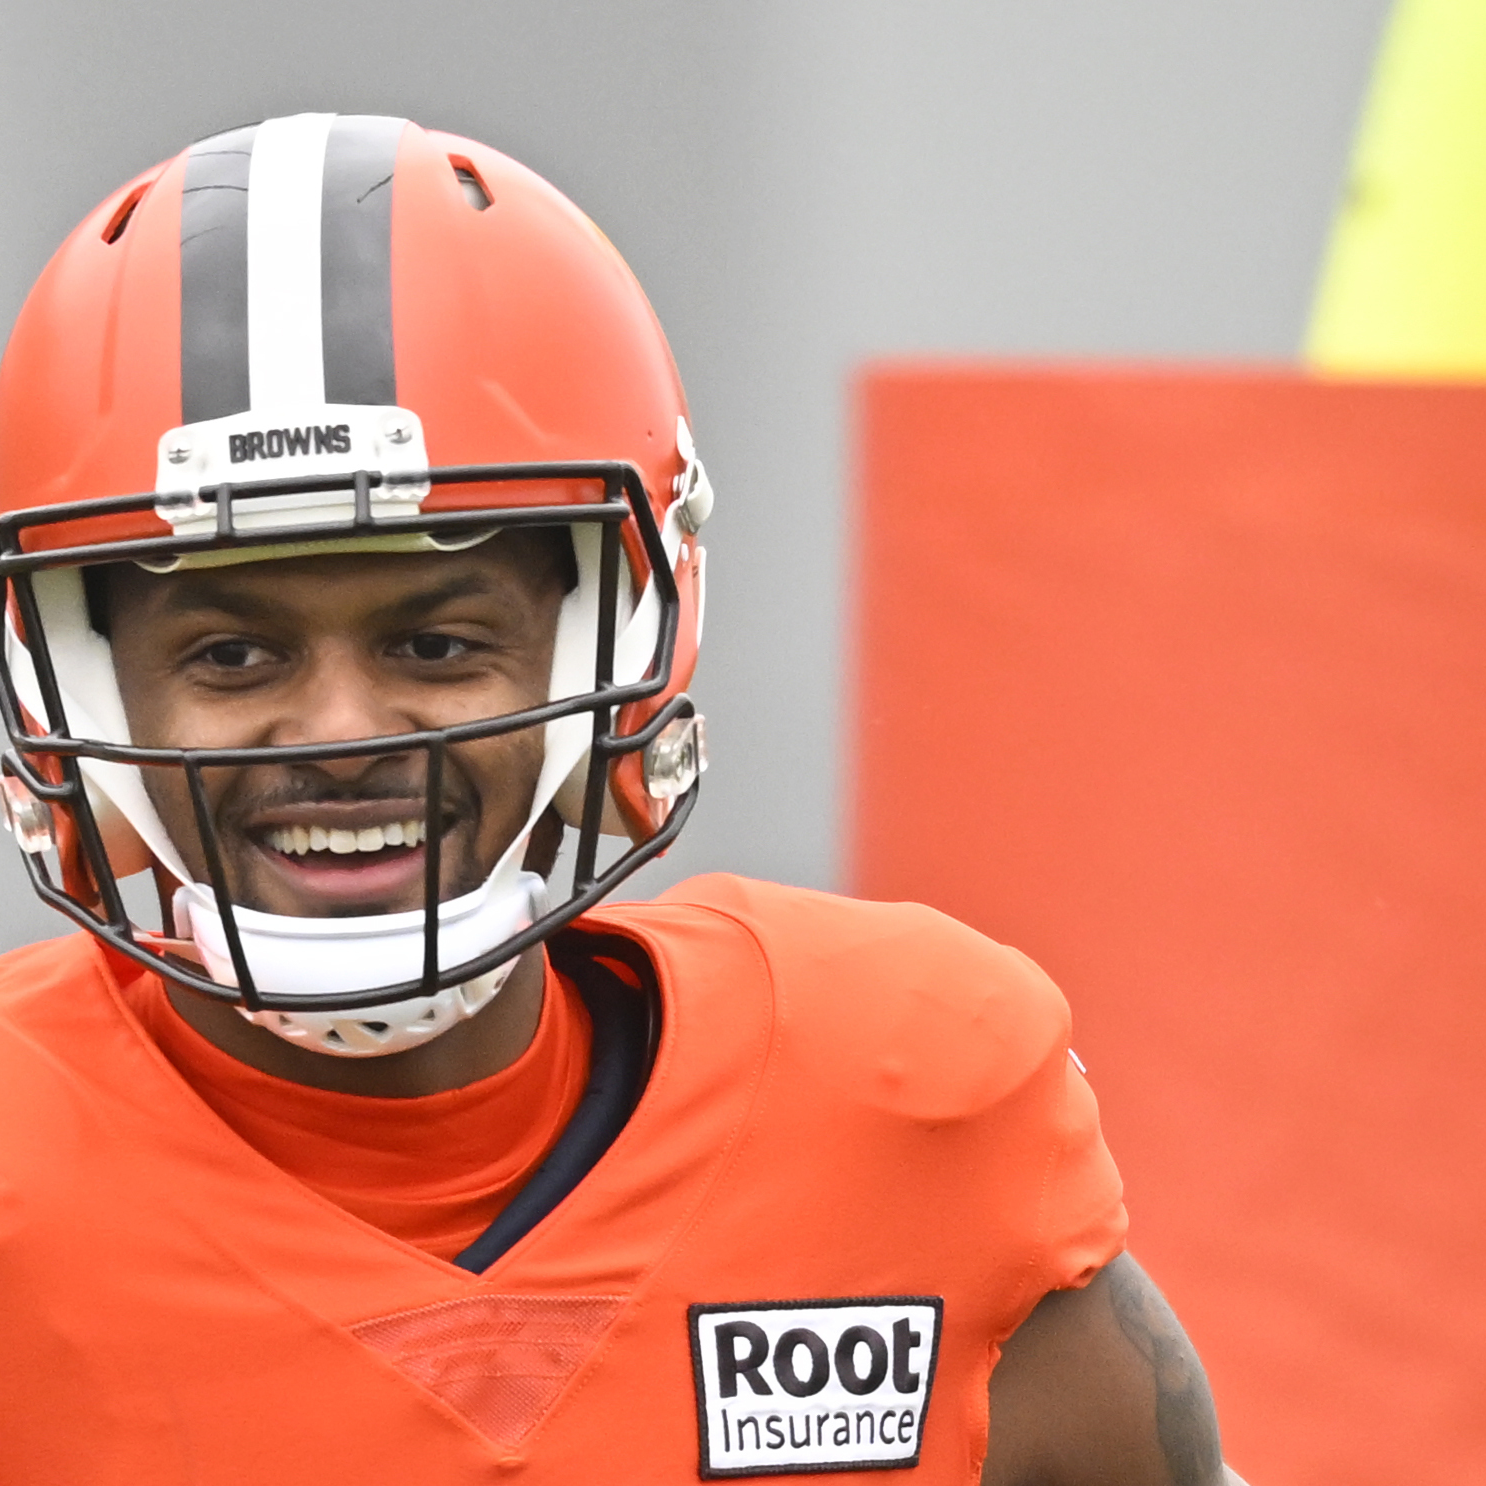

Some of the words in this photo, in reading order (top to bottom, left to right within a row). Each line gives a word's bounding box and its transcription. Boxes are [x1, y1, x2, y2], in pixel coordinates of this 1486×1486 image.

[228, 424, 351, 463] BROWNS
[714, 1317, 921, 1399] Root
[721, 1408, 915, 1453] Insurance
